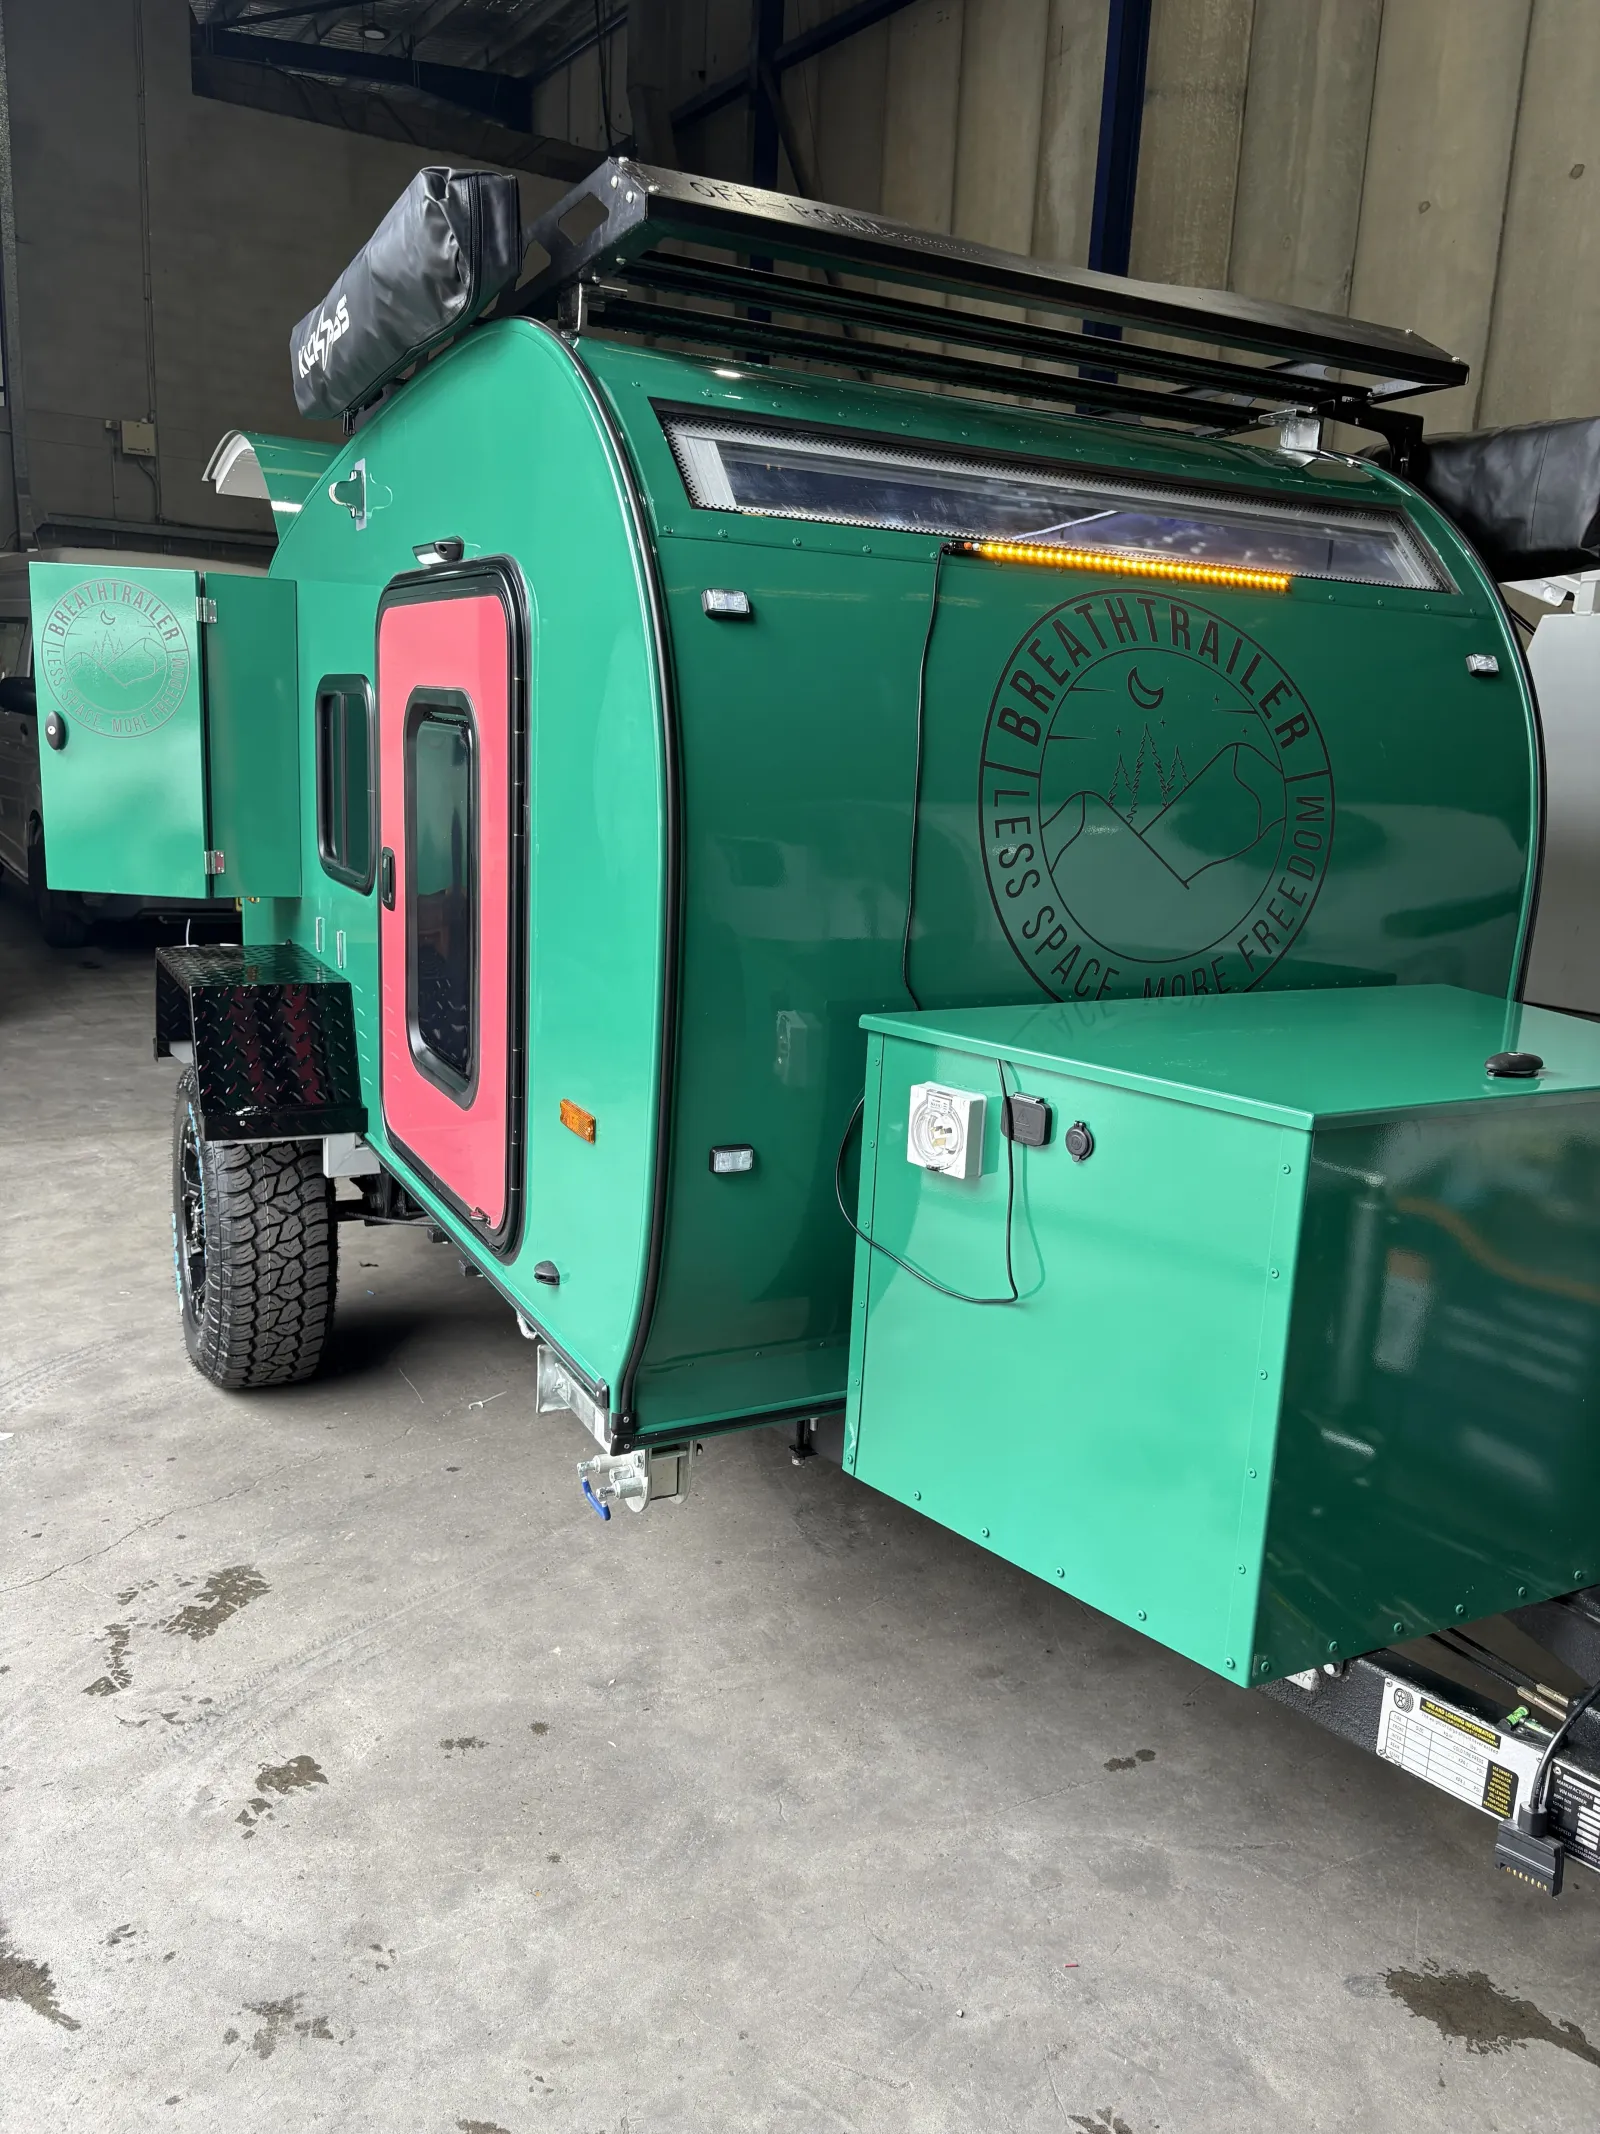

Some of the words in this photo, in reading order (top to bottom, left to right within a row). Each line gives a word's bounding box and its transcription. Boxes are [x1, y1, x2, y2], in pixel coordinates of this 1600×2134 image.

[48, 582, 180, 641] BREATHTRAILER
[46, 649, 67, 687] LESS
[61, 689, 103, 726] SPACE
[112, 712, 151, 733] MORE
[151, 658, 187, 721] FREEDOM
[997, 596, 1311, 749] BREATHTRAILER
[994, 789, 1042, 898] LESS
[1143, 956, 1232, 998] MORE
[1237, 795, 1326, 973] FREEDOM
[1465, 1720, 1496, 1740] INFORMATION
[1556, 1779, 1593, 1800] MANUFACTURER
[1567, 1791, 1587, 1805] NUMBER
